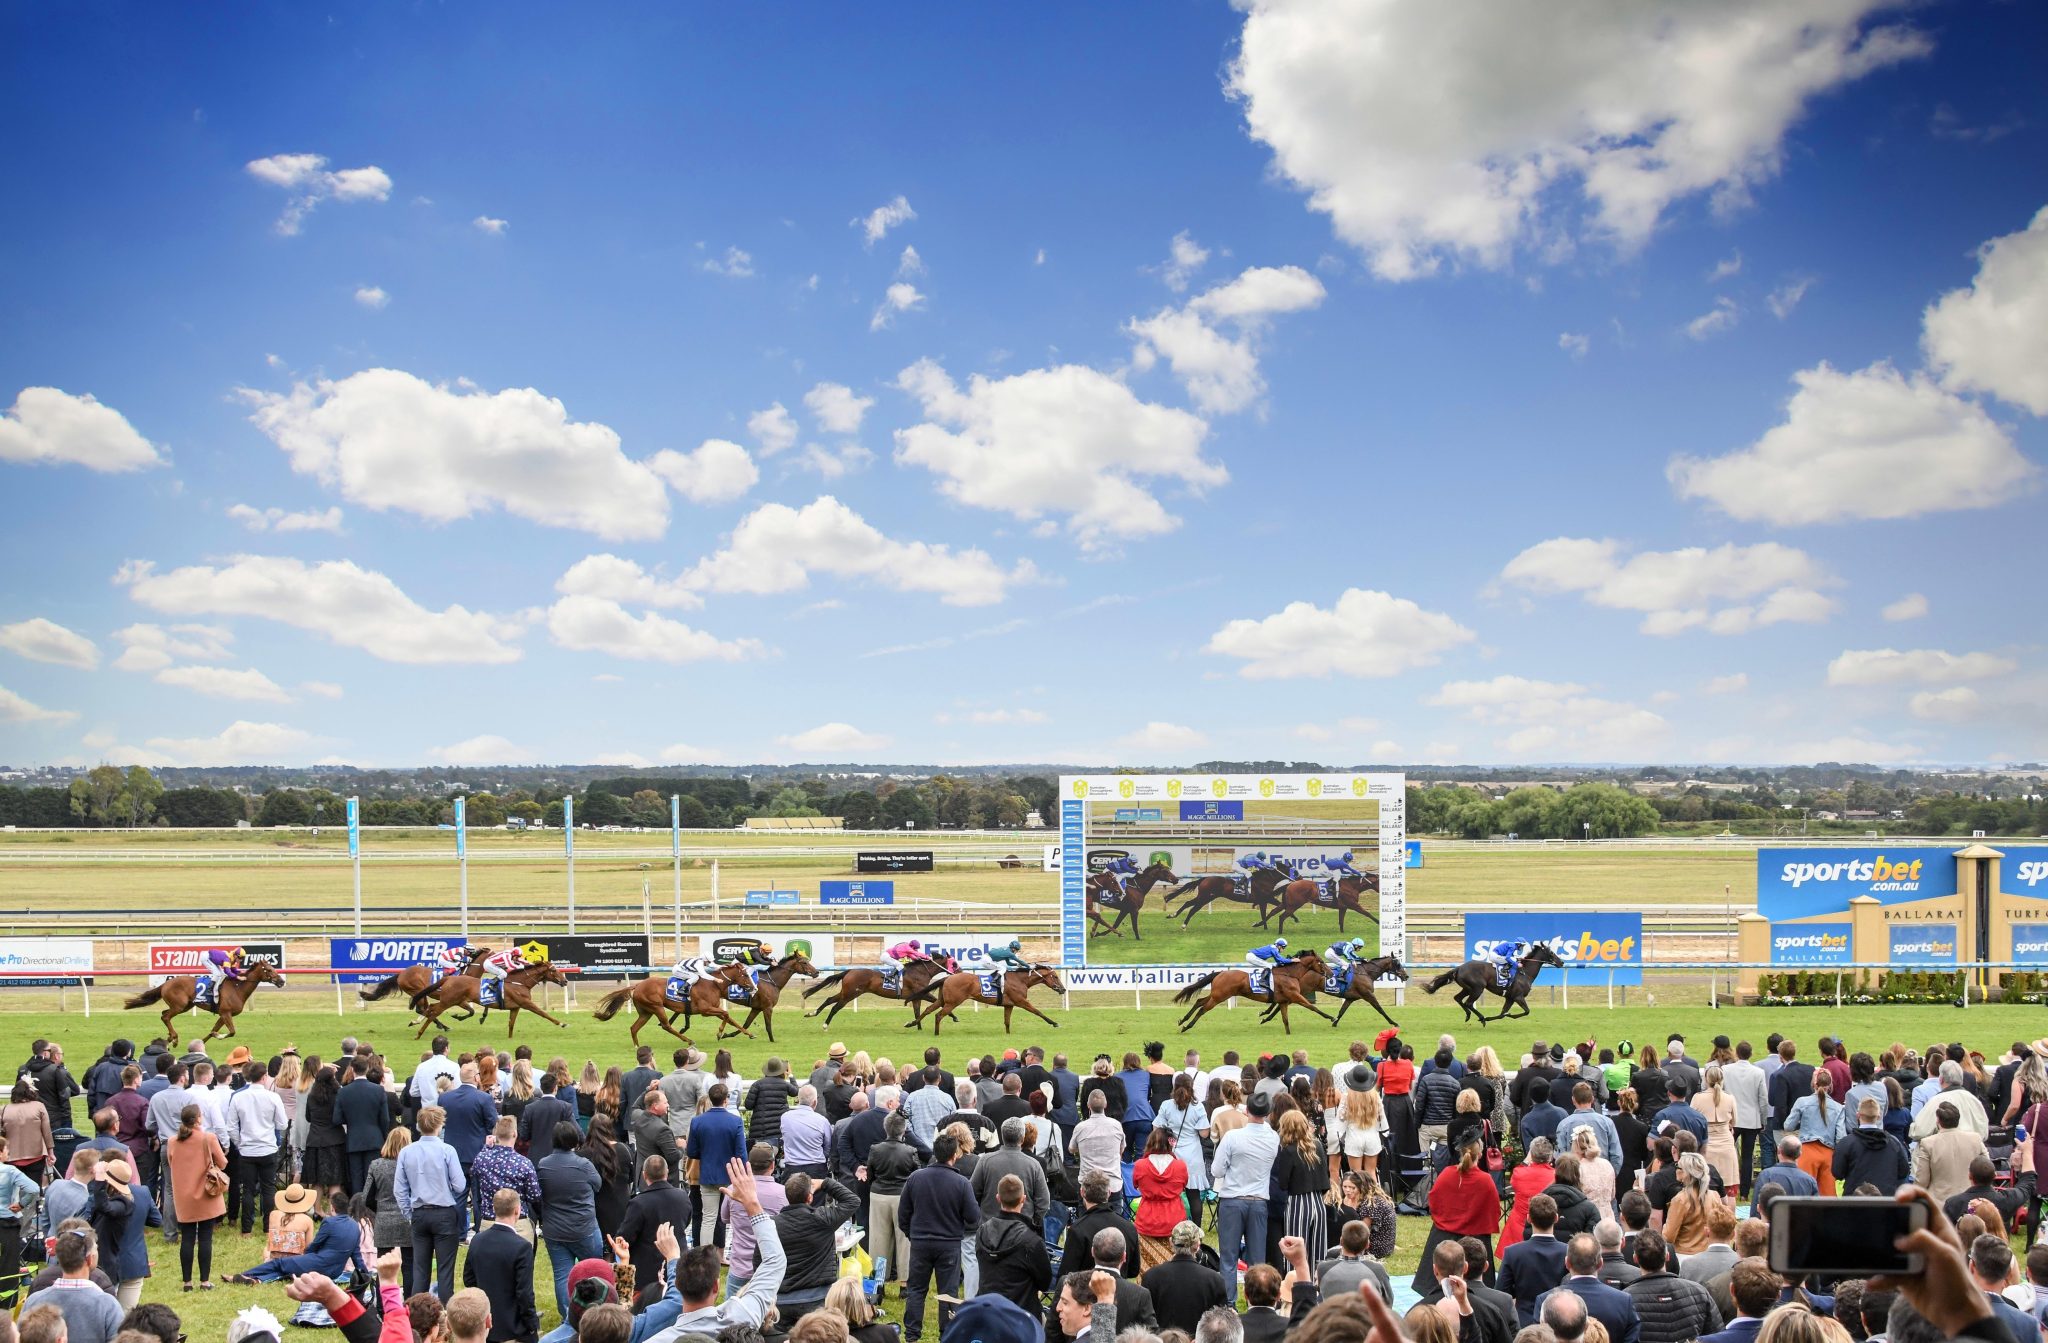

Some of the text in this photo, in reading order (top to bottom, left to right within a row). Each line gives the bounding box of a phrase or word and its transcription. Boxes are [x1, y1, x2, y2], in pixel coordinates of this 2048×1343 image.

[1781, 855, 1923, 887] sportsbet
[1319, 884, 1329, 896] 5
[1870, 882, 1920, 891] .com.au
[1884, 910, 1964, 919] BALLARAT
[2005, 909, 2040, 918] TURF
[1471, 932, 1635, 961] sotsbet
[1774, 933, 1847, 950] sportsbet
[1893, 941, 1953, 955] sportsbet
[370, 942, 448, 961] PORTER
[8, 954, 22, 964] Pro
[195, 982, 207, 999] 2
[668, 981, 678, 995] 4
[981, 977, 991, 992] 5
